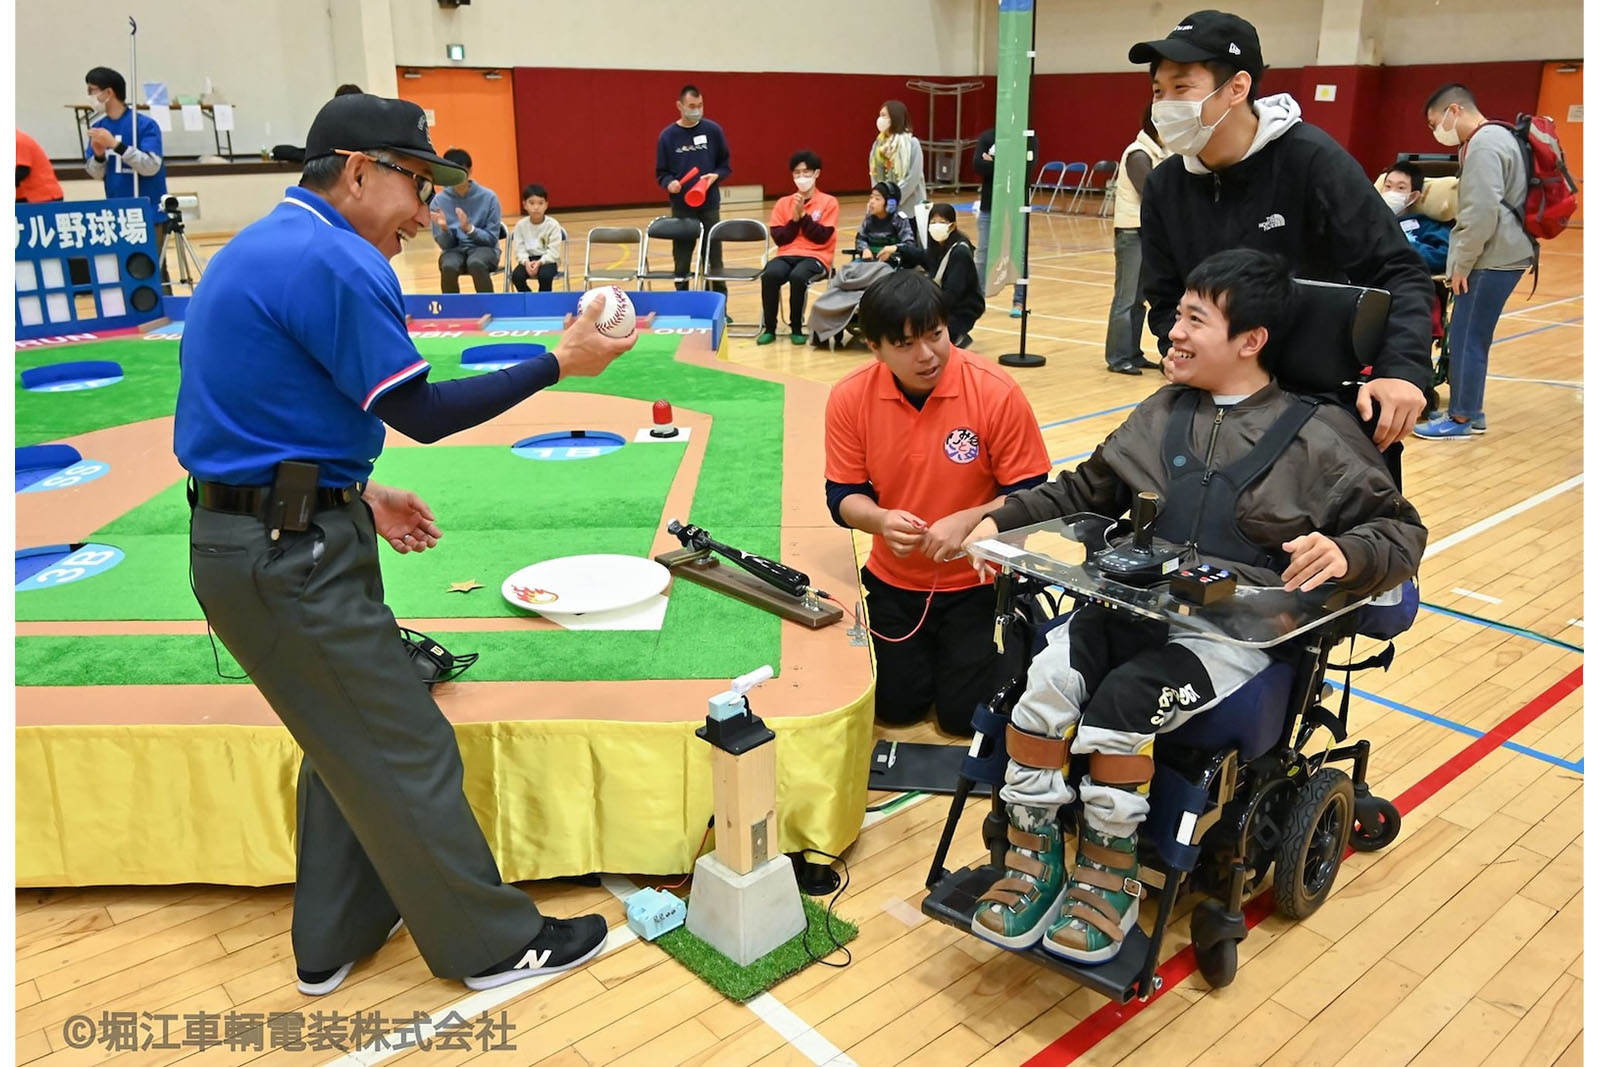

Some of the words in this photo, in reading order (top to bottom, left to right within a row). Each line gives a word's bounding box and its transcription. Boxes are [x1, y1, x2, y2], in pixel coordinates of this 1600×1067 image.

[488, 329, 549, 337] OUT
[42, 465, 103, 487] SS
[37, 551, 116, 582] 3B
